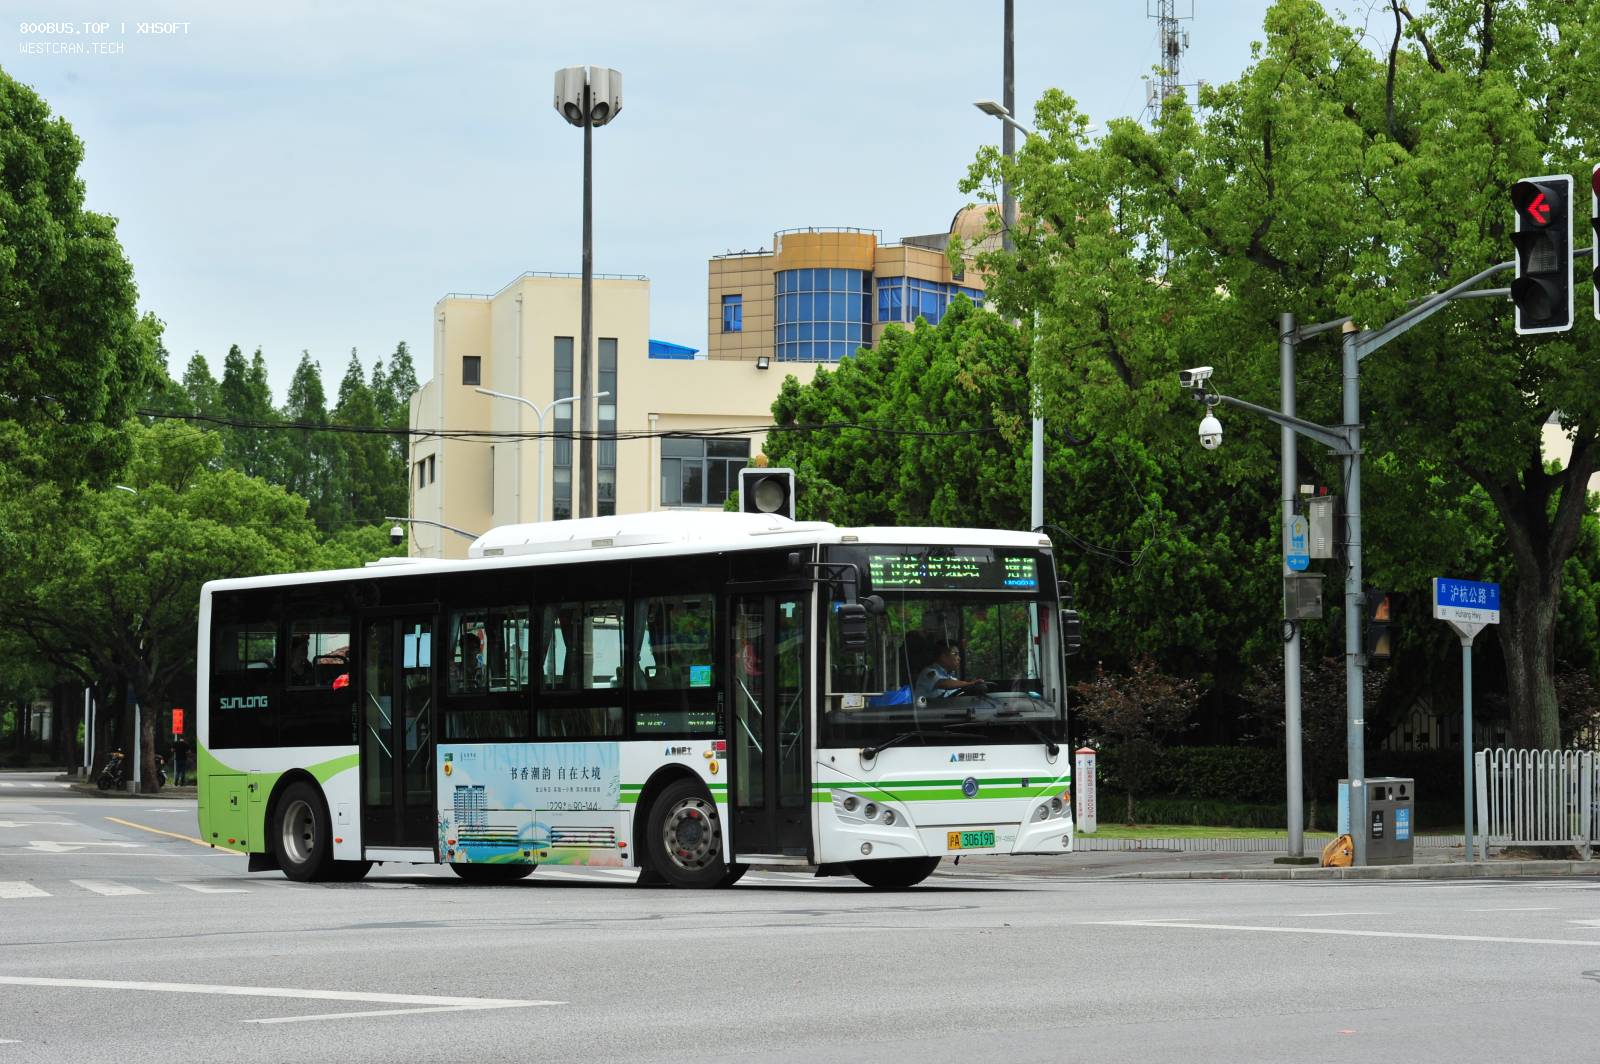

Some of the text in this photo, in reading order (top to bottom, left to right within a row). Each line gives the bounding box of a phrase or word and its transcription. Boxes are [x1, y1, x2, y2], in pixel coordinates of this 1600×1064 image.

[1450, 584, 1486, 604] 沪杭公路
[219, 695, 268, 709] SUNLONG
[558, 766, 601, 780] 自在大境
